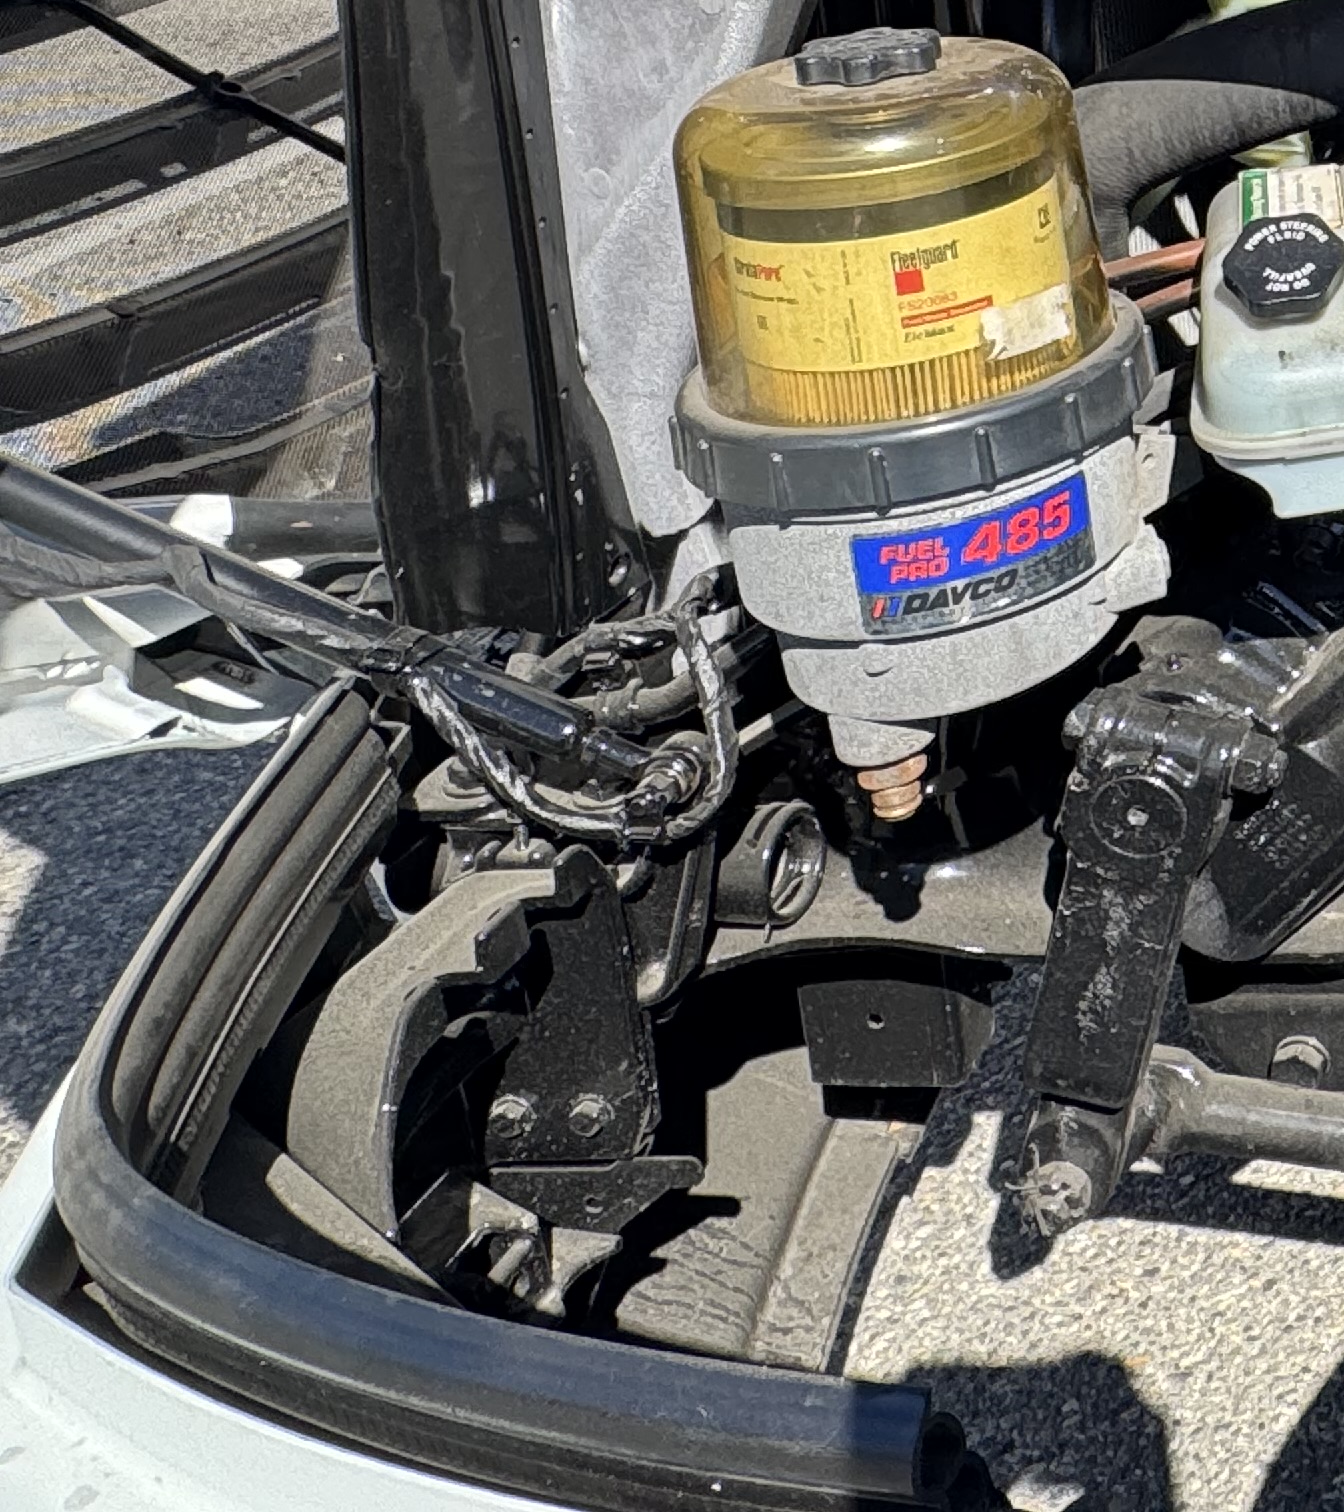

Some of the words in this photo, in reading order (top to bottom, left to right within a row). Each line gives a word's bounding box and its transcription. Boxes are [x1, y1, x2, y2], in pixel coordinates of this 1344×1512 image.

[1244, 224, 1277, 251] POWER
[1280, 220, 1329, 243] STEERING
[1267, 230, 1305, 244] FLUID
[890, 239, 960, 272] Fleetguard
[879, 536, 949, 565] FUEL
[961, 490, 1070, 564] 485
[890, 556, 949, 584] PRO
[902, 568, 1018, 616] DAVCO
